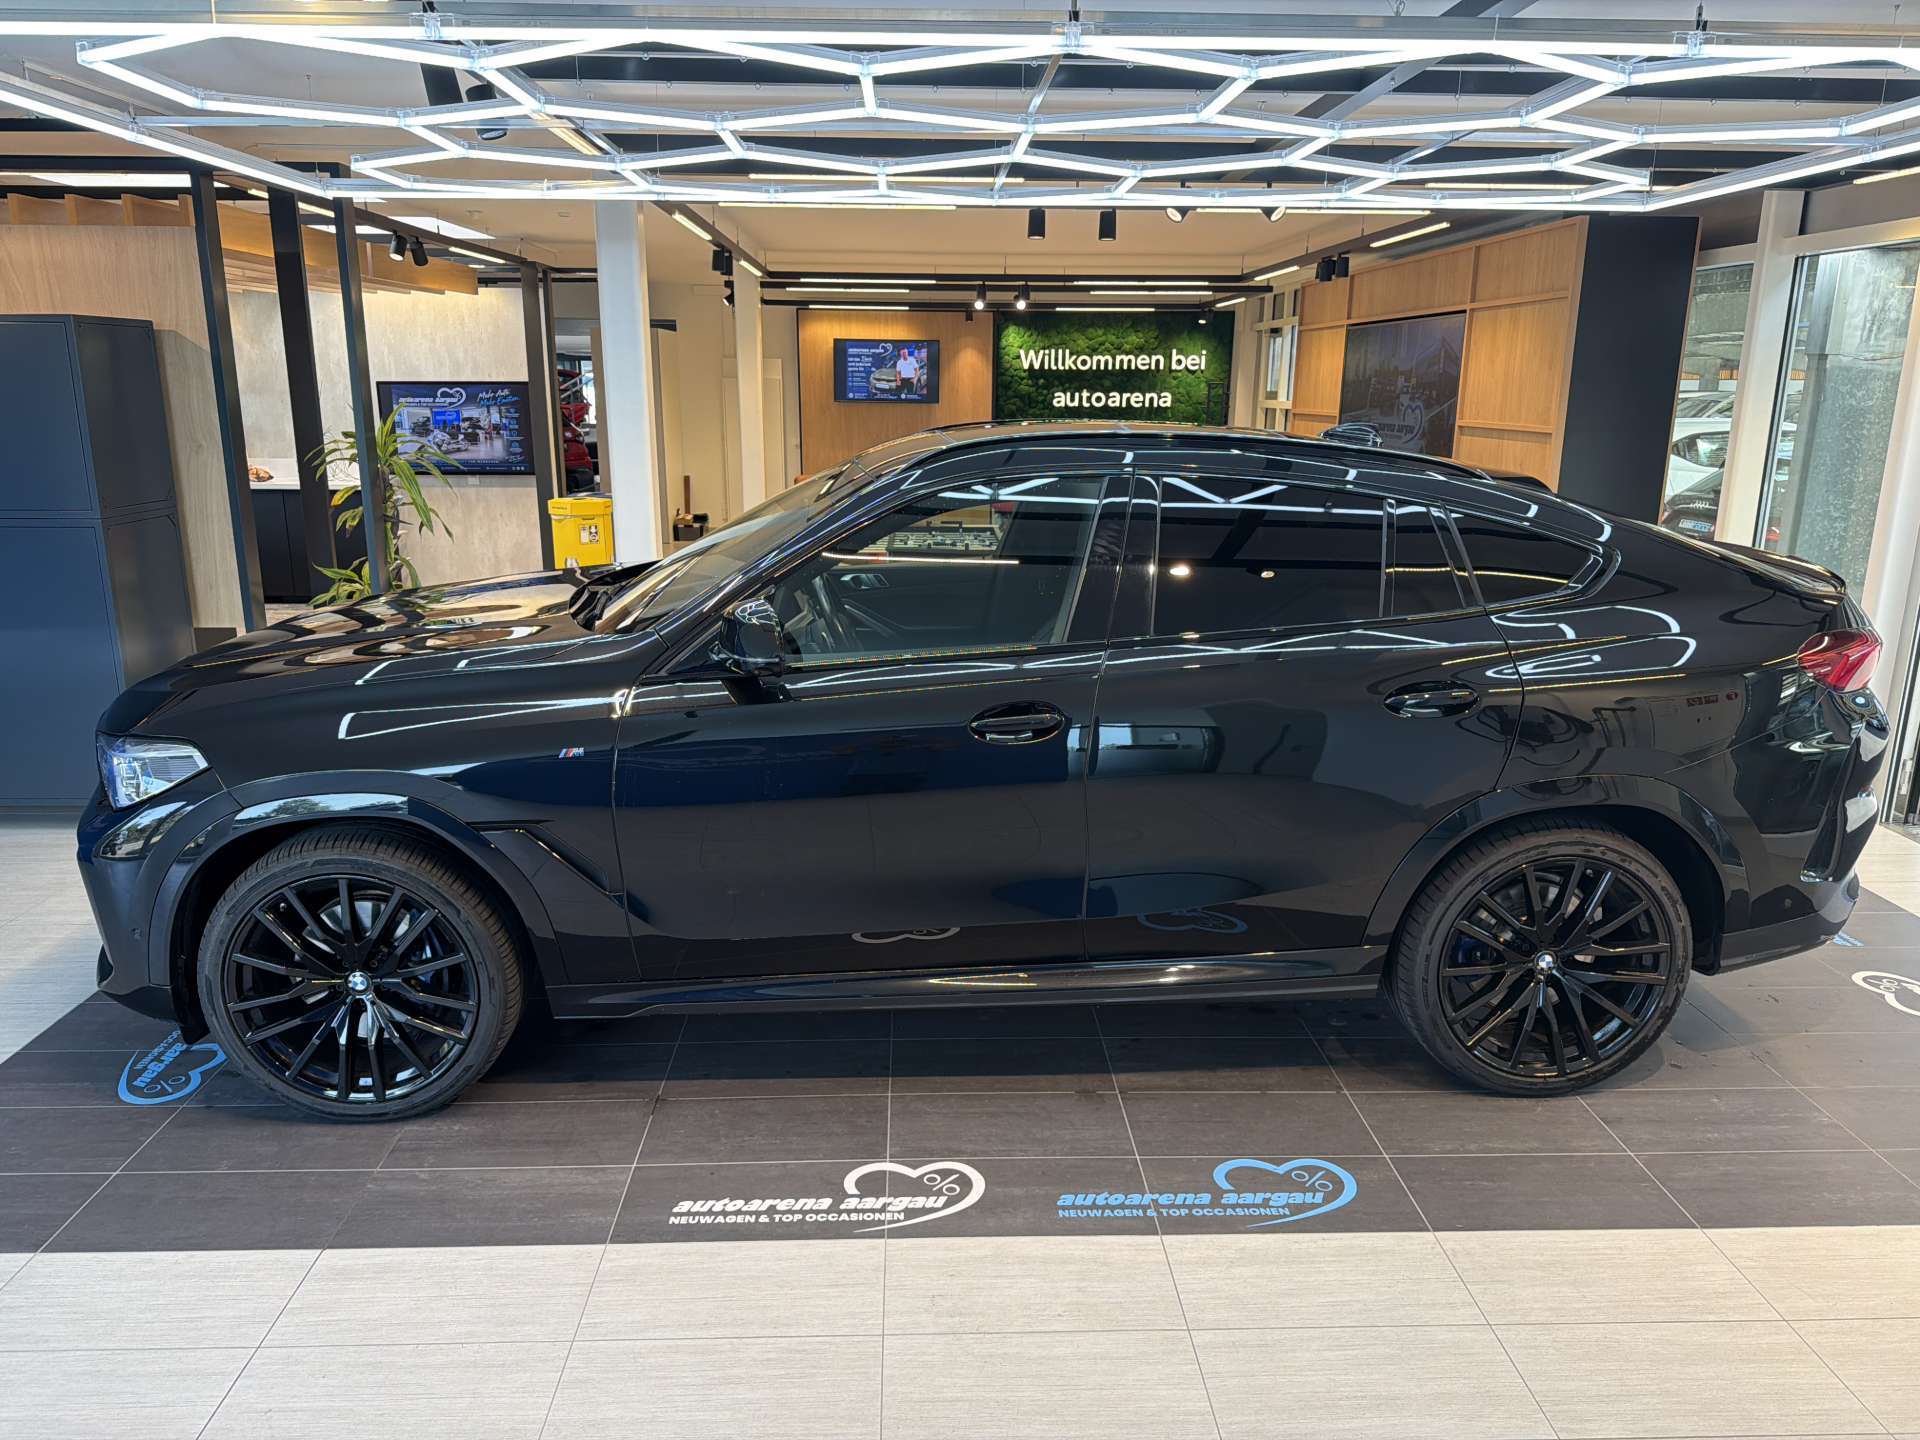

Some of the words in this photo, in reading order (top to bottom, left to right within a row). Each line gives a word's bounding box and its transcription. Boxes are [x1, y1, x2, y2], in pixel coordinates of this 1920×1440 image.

[1020, 348, 1164, 371] Willkommen
[1171, 348, 1207, 371] bei
[1052, 388, 1172, 408] autoarena
[671, 1197, 833, 1212] autoarena
[839, 1196, 948, 1211] aargau
[1056, 1191, 1212, 1206] autoarena
[1221, 1191, 1324, 1206] aargau
[668, 1214, 756, 1224] NEUWAGEN
[758, 1214, 770, 1223] &
[773, 1213, 803, 1222] TOP
[805, 1212, 905, 1222] OCCASIONEN
[1058, 1208, 1144, 1217] NEUWAGEN
[1146, 1208, 1158, 1217] &
[1160, 1208, 1189, 1217] TOP
[1191, 1207, 1290, 1216] OCCASIONEN
